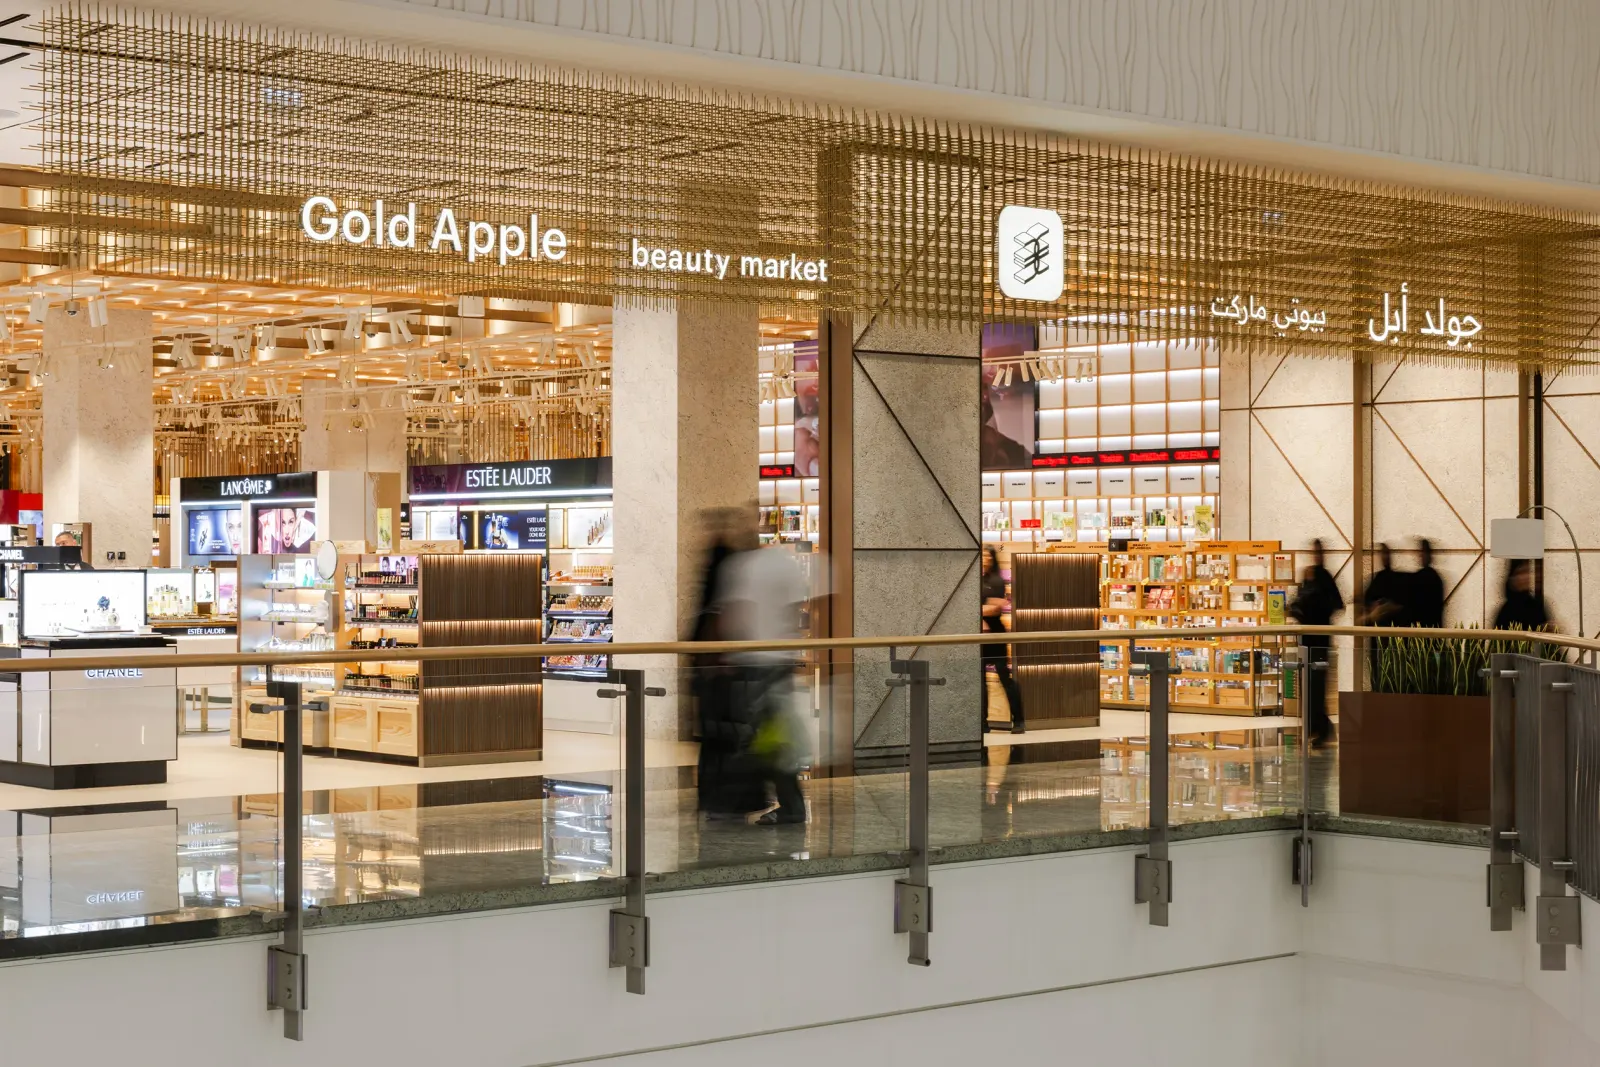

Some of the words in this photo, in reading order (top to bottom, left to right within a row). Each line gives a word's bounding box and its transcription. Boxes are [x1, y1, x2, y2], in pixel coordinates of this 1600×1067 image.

[300, 196, 416, 249] Gold
[430, 207, 568, 265] Apple
[631, 237, 731, 281] beauty
[740, 253, 829, 283] market
[1211, 294, 1267, 326] ماركت
[1273, 299, 1328, 336] بيوتي
[1368, 282, 1410, 345] أبل
[1420, 297, 1483, 348] جولد
[221, 478, 264, 495] LANCÔME
[466, 467, 500, 488] ESTÉE
[502, 466, 552, 487] LAUDER
[204, 627, 226, 635] LAUDER
[86, 668, 143, 678] CHANEL
